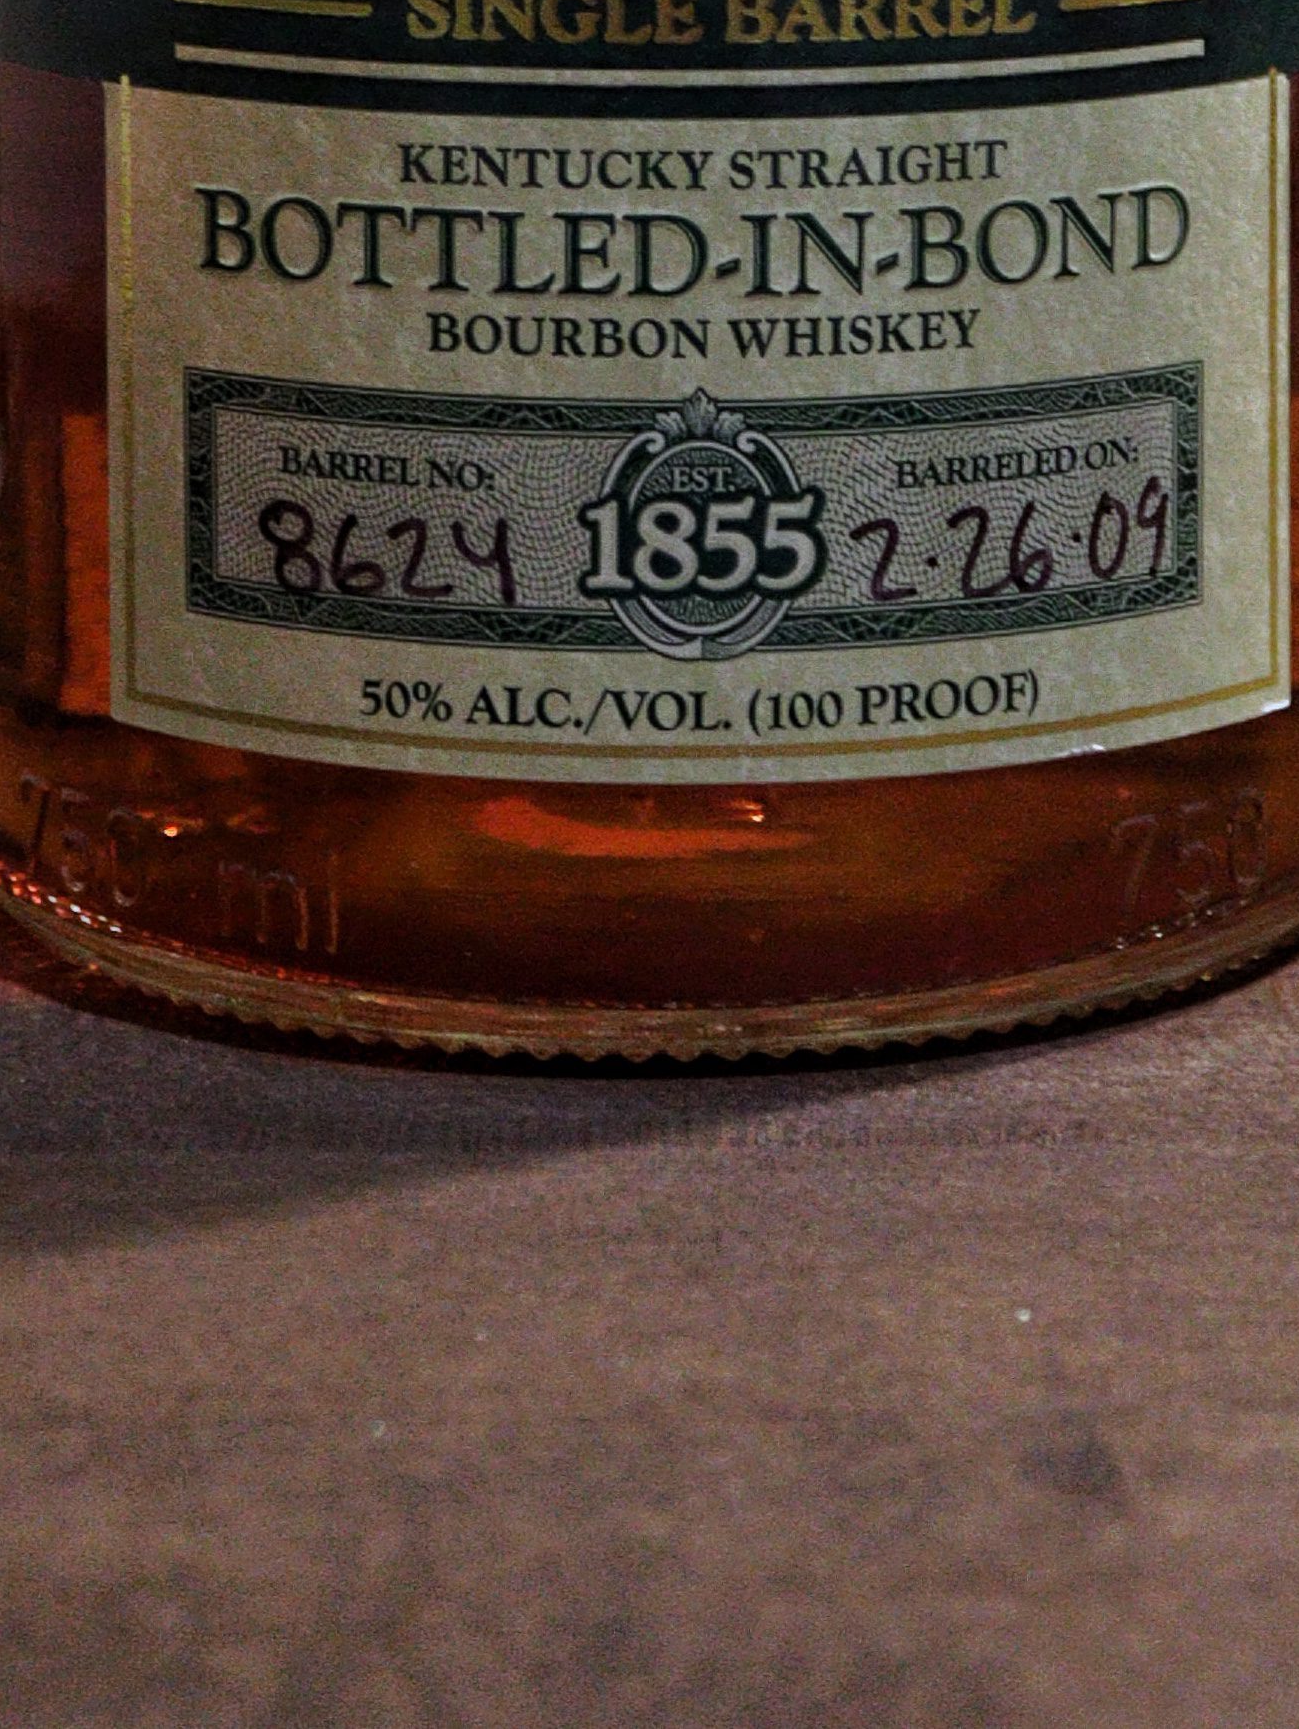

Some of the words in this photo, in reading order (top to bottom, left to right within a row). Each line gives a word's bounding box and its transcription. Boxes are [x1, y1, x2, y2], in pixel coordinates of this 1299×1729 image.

[398, 143, 713, 191] KENTUCKY
[728, 140, 1008, 189] STRAIGHT
[196, 184, 1191, 298] BOTTLED-IN-BOND
[426, 311, 712, 360] BOURBON
[727, 308, 981, 358] WHISKEY
[279, 446, 420, 488] BARREL
[671, 465, 735, 491] EST.
[896, 445, 1078, 489] BARRELED
[257, 499, 518, 606] 8624
[584, 495, 817, 592] 1855
[359, 679, 454, 723] 50%
[466, 688, 732, 736] ALC./VOL.
[747, 686, 843, 735] (100
[857, 669, 1040, 725] PROOF)
